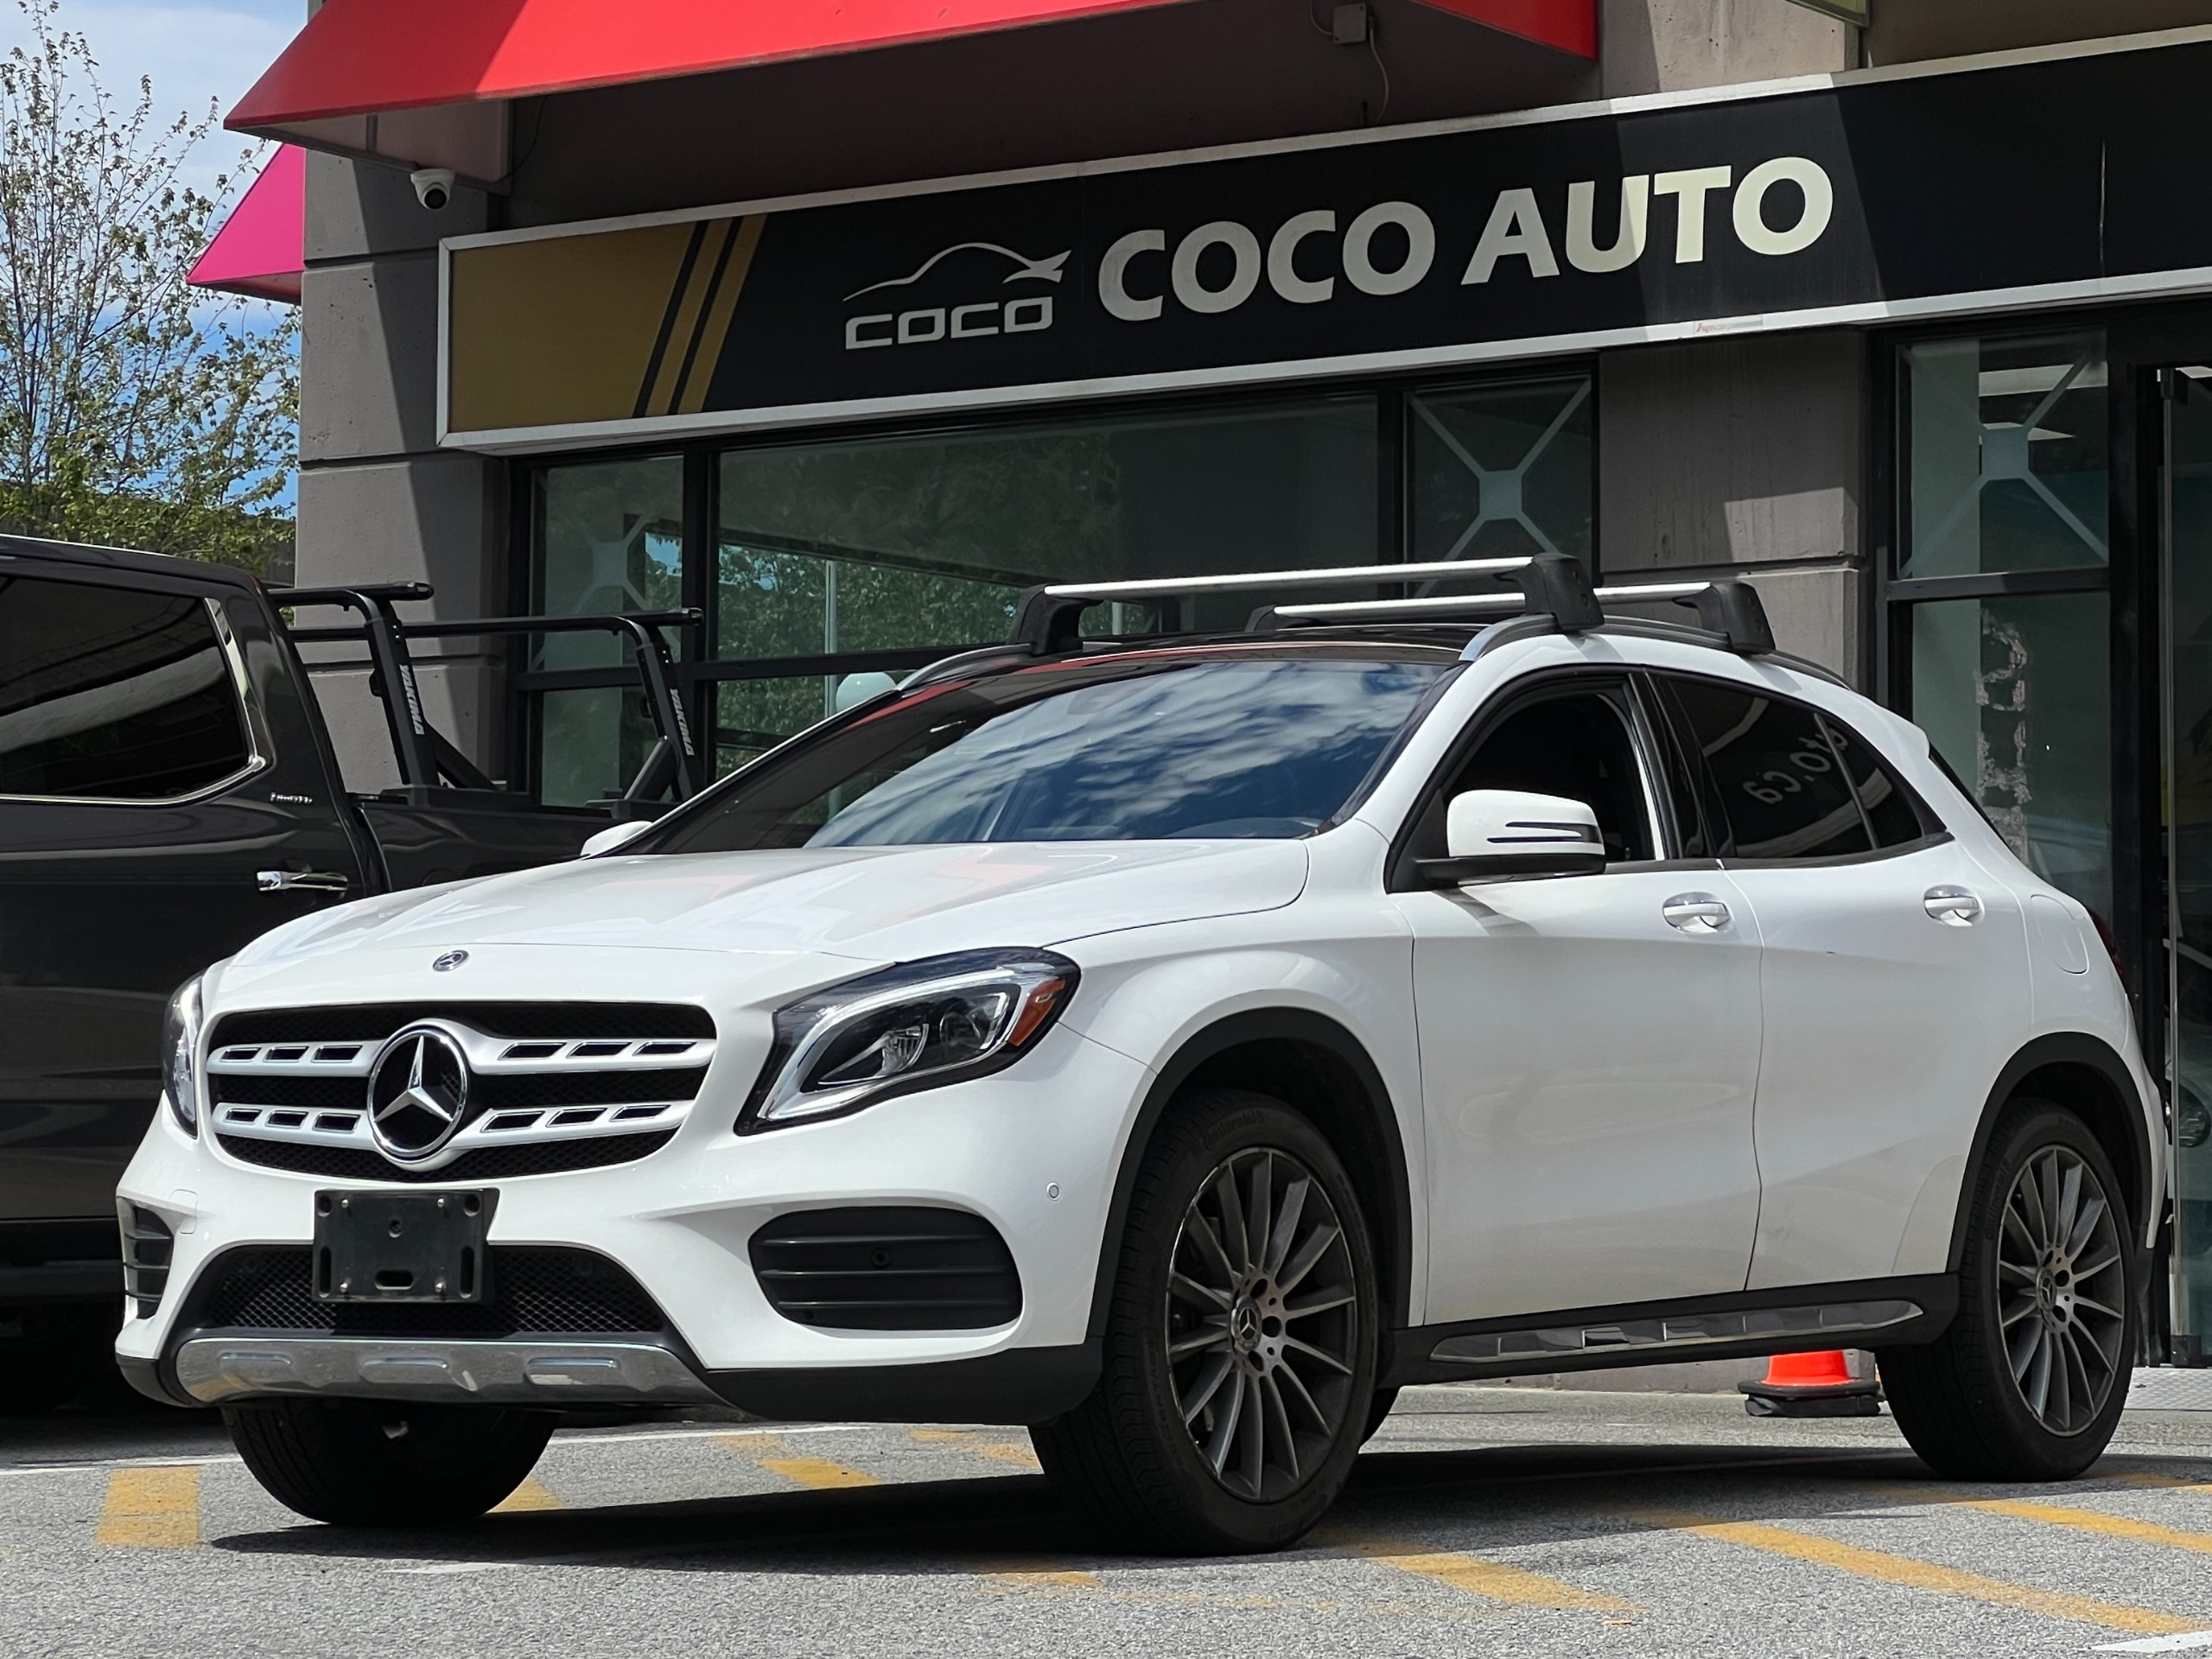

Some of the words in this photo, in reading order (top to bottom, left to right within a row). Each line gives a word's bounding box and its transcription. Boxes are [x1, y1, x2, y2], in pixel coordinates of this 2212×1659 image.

[1098, 201, 1436, 321] COCO
[1461, 156, 1834, 284] AUTO
[845, 297, 1053, 350] COCO
[399, 664, 425, 735] YAKIMA
[670, 689, 696, 756] YAKIMA
